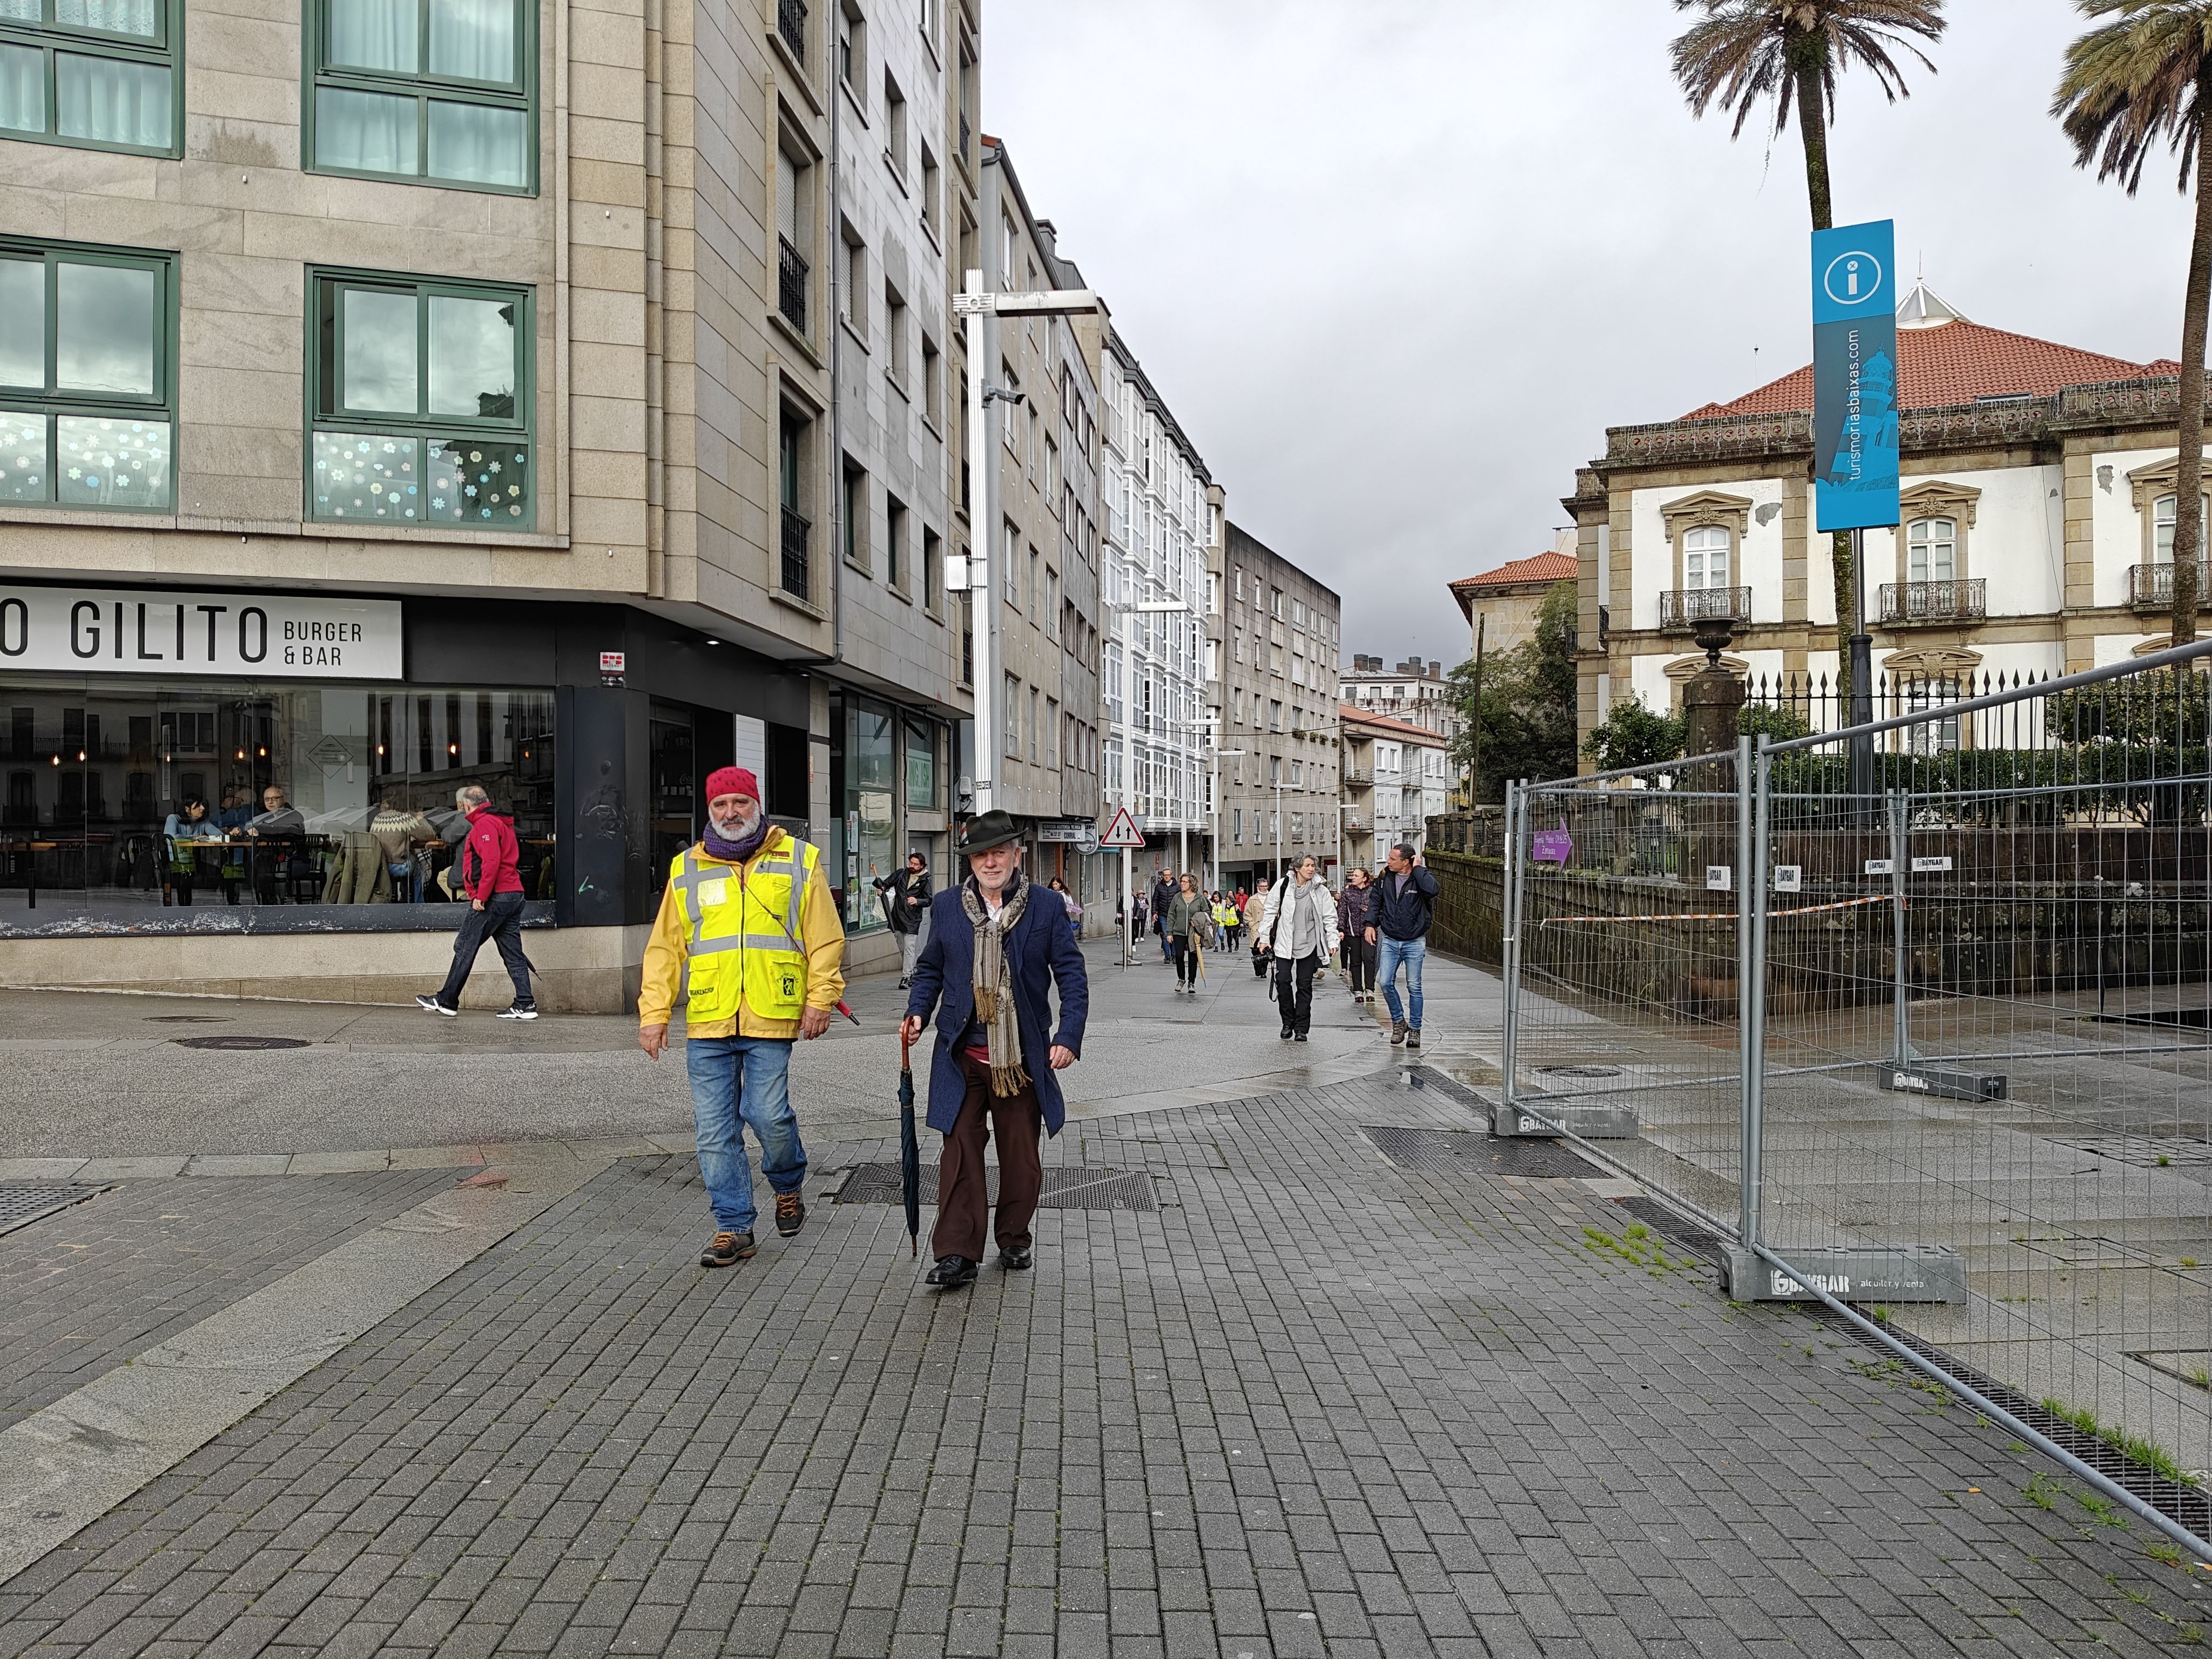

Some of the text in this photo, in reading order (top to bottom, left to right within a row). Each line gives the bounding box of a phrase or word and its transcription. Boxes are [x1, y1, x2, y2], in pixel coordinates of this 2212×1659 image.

[1846, 329, 1861, 481] turismoriasbaixas.com
[71, 600, 267, 663] GILITO
[284, 621, 361, 642] BURGER
[285, 646, 341, 666] & BAR
[1894, 1281, 1899, 1289] y
